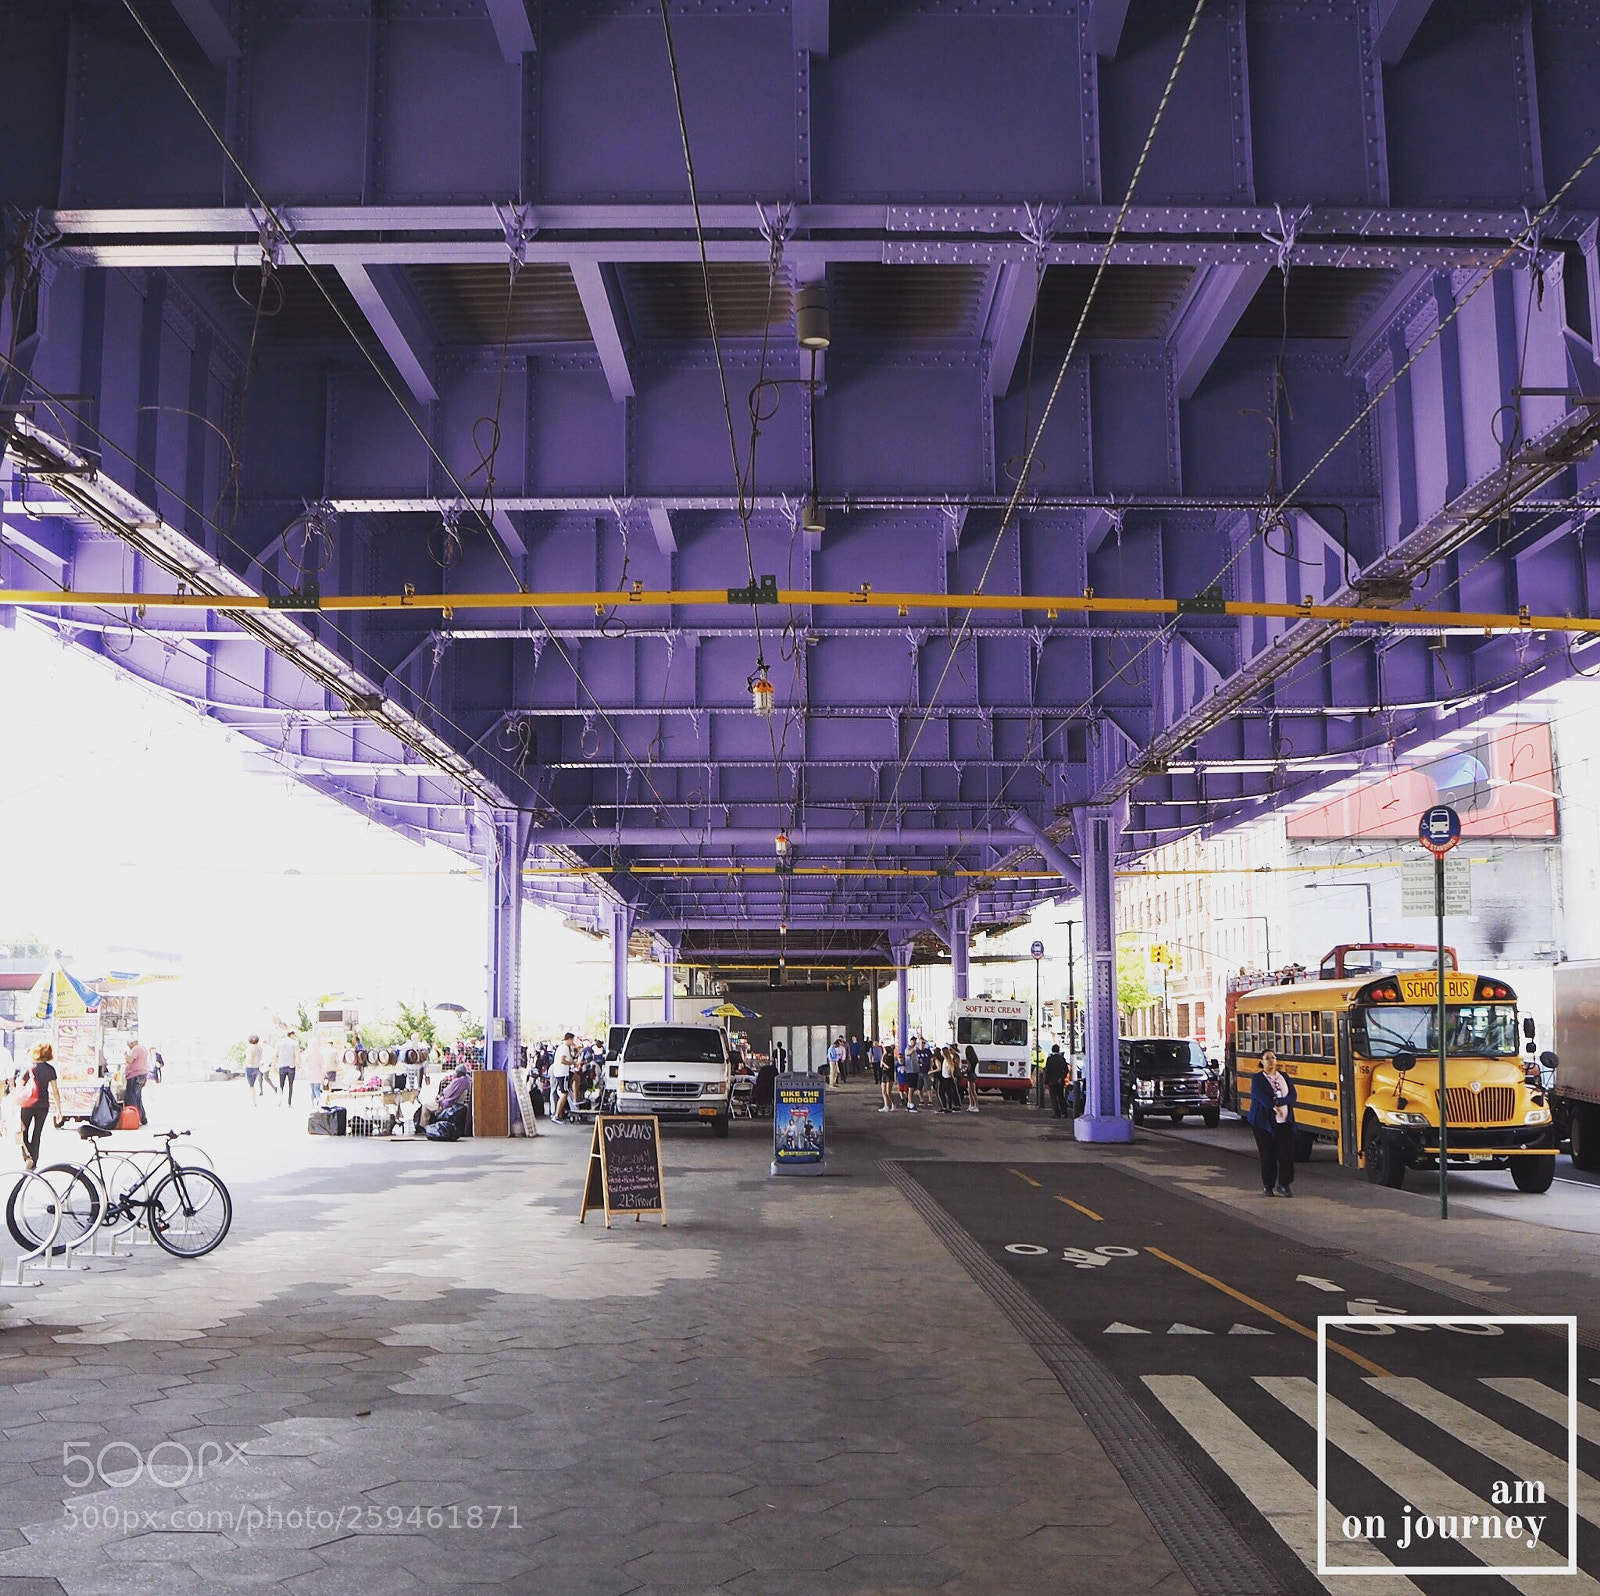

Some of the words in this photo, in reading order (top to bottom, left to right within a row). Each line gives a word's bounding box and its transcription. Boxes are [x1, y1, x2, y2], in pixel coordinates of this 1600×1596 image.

[1430, 838, 1456, 851] STANDING
[1448, 981, 1469, 997] BUS
[997, 1006, 1021, 1014] CREAM
